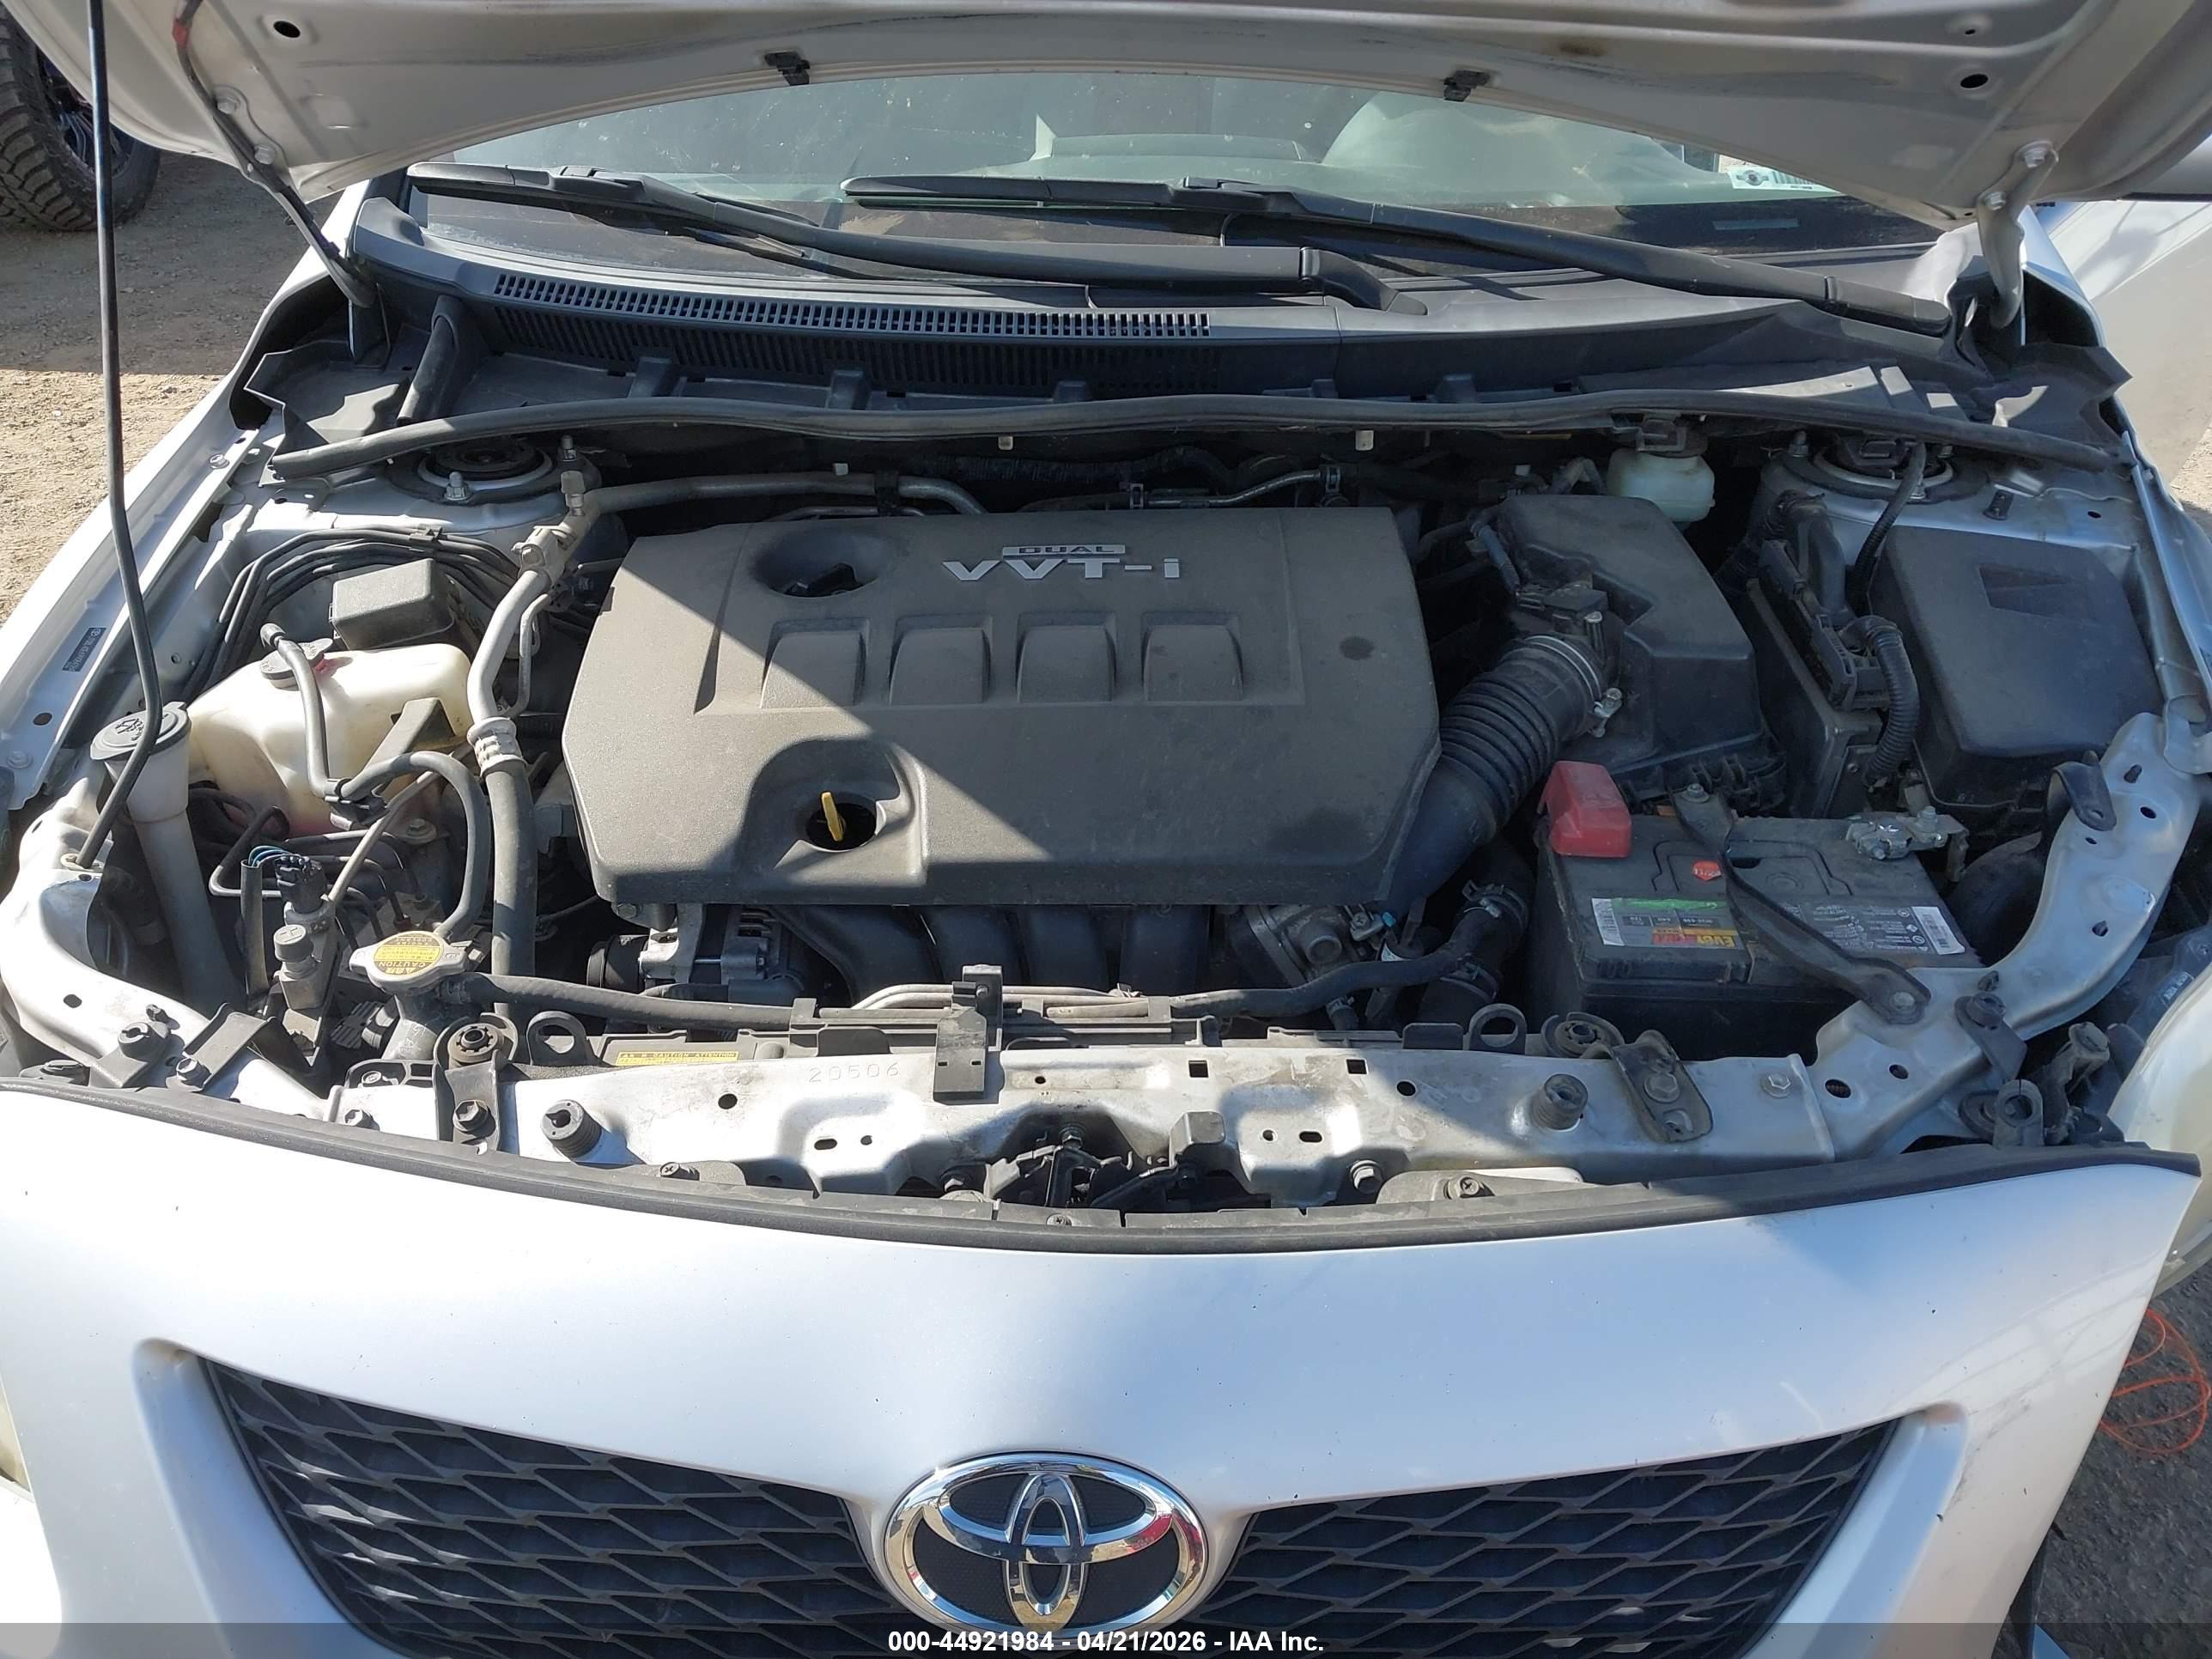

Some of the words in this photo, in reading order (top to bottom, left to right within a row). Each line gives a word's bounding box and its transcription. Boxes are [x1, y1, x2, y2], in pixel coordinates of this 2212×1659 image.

[1018, 545, 1115, 554] DUAL
[942, 558, 1180, 581] VVT-i
[809, 1061, 898, 1083] 20506
